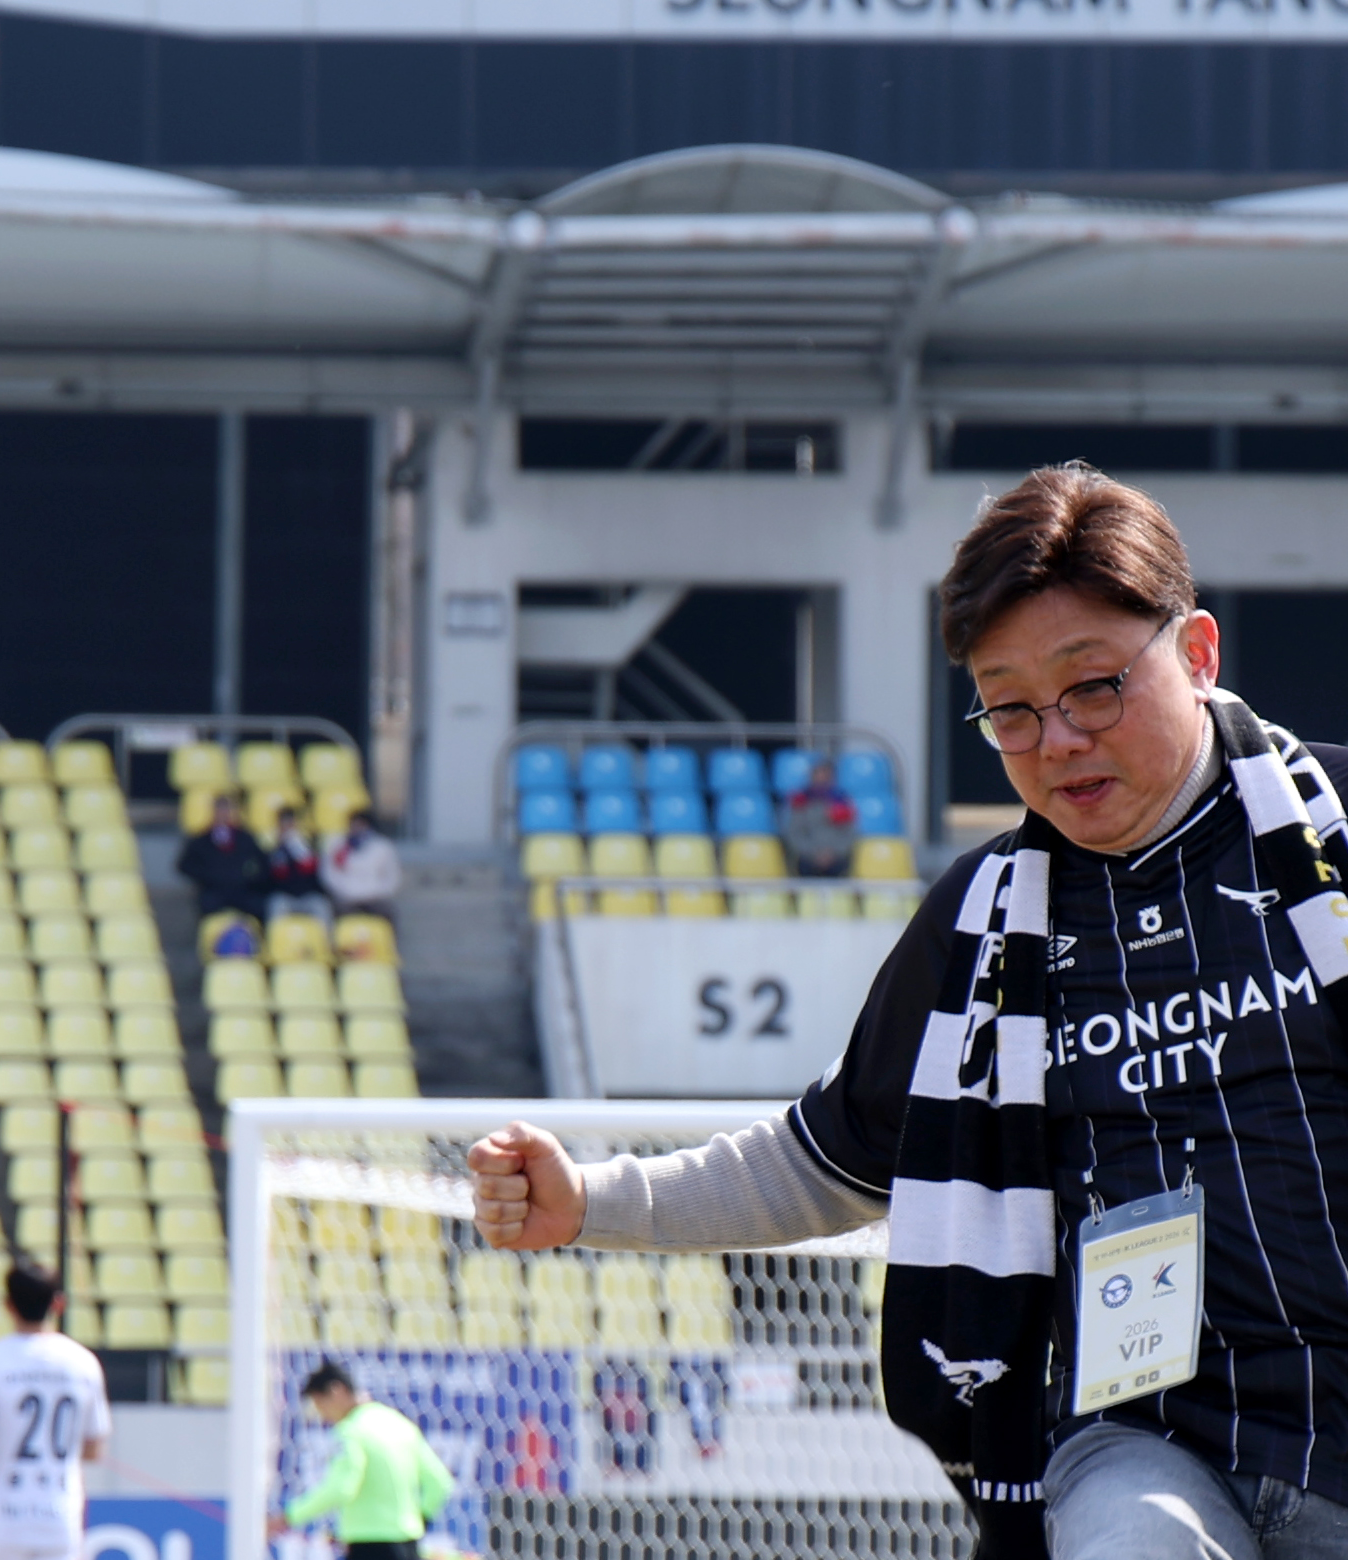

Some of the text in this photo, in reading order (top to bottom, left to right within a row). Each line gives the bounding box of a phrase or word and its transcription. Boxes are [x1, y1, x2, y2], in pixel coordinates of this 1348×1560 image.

[697, 977, 788, 1037] S2
[1118, 1031, 1228, 1094] CITY
[1119, 1333, 1163, 1362] VIP
[1125, 1319, 1159, 1339] 2026
[15, 1392, 77, 1461] 20
